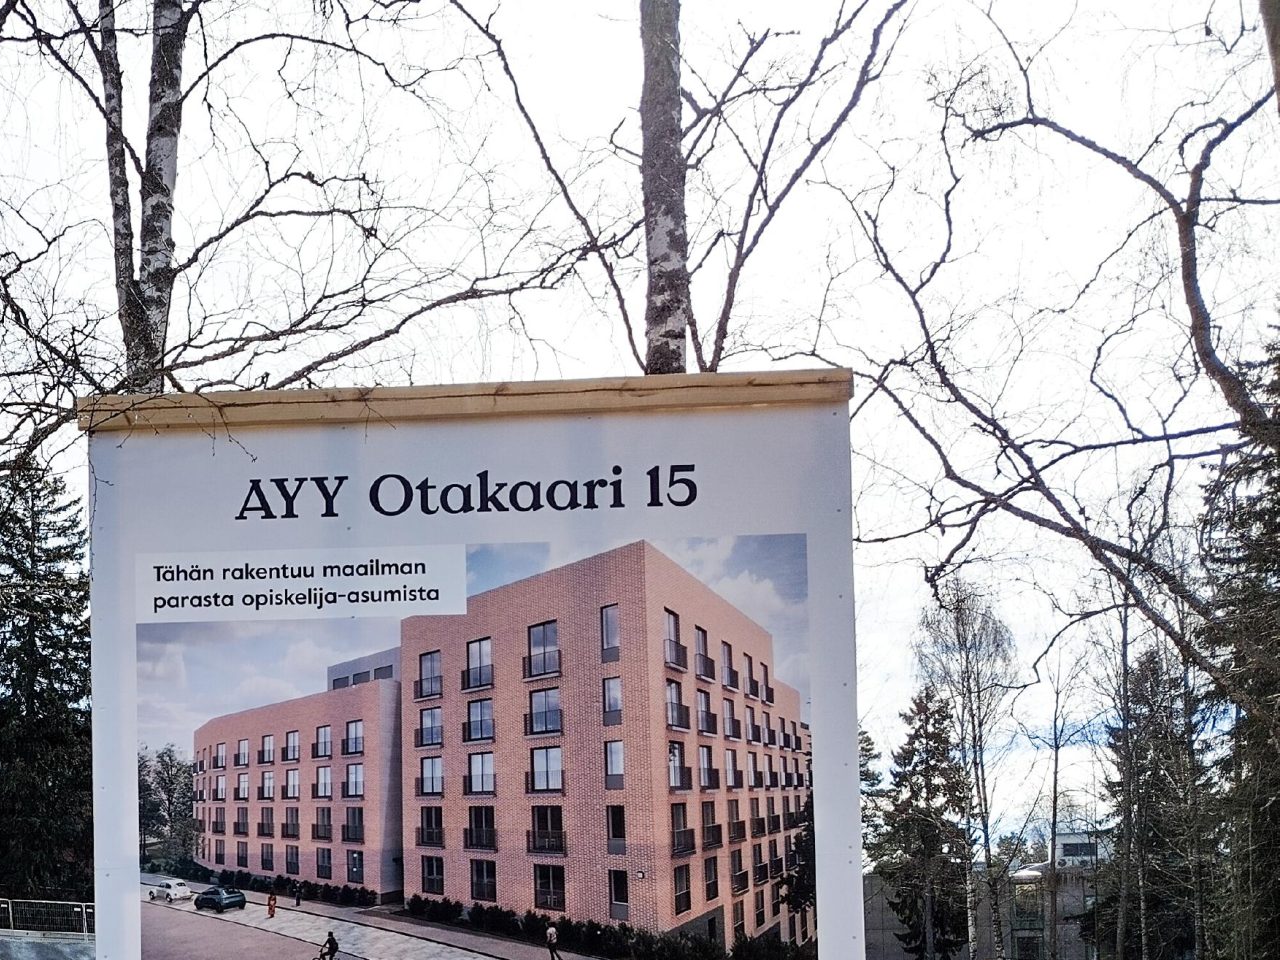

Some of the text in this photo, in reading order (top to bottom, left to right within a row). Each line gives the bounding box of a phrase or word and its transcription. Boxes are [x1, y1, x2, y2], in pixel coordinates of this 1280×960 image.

[234, 463, 698, 521] AYY Otakaari 15
[152, 558, 427, 583] Tähän rakentuu maailman
[153, 584, 440, 614] parasta opiskelija-asumista
